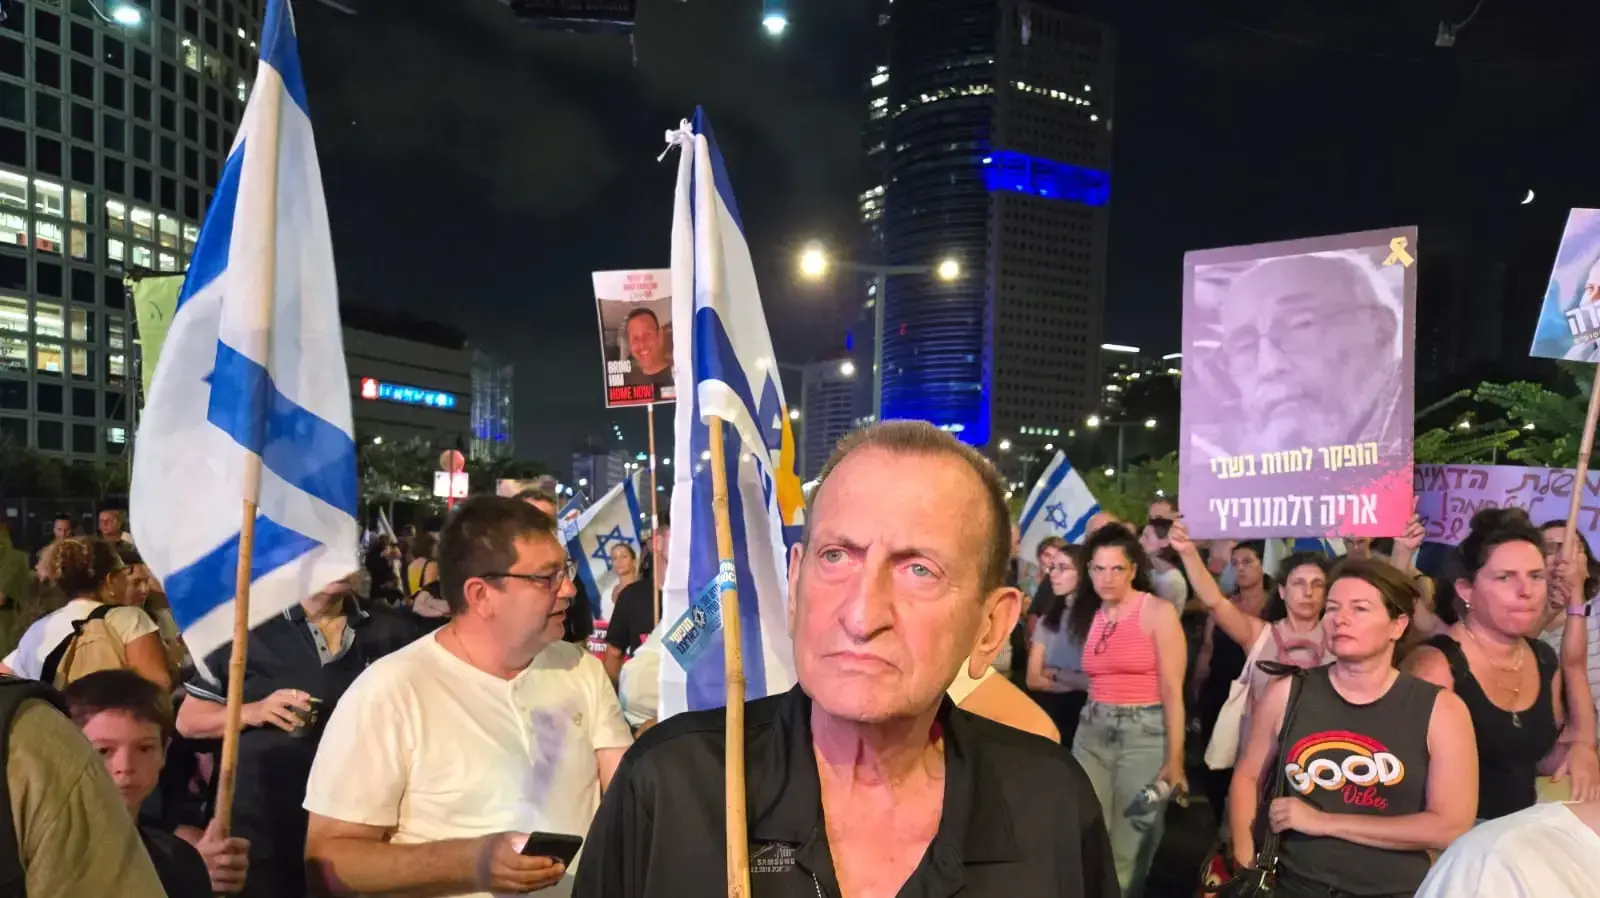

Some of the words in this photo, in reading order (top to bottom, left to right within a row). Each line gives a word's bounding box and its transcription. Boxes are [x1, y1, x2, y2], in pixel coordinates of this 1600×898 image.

[607, 360, 632, 374] BRING
[608, 374, 625, 387] HIM
[609, 386, 633, 400] HOME
[634, 384, 654, 399] NOW!
[1210, 453, 1257, 479] בשבי
[1261, 446, 1313, 475] למוות
[1318, 442, 1379, 471] הופקר
[1209, 494, 1314, 531] זלמנוביץ'
[1320, 493, 1378, 525] אריה
[1285, 752, 1404, 795] GOOD
[1341, 784, 1388, 811] Vibes
[757, 858, 796, 866] SAMSUNG
